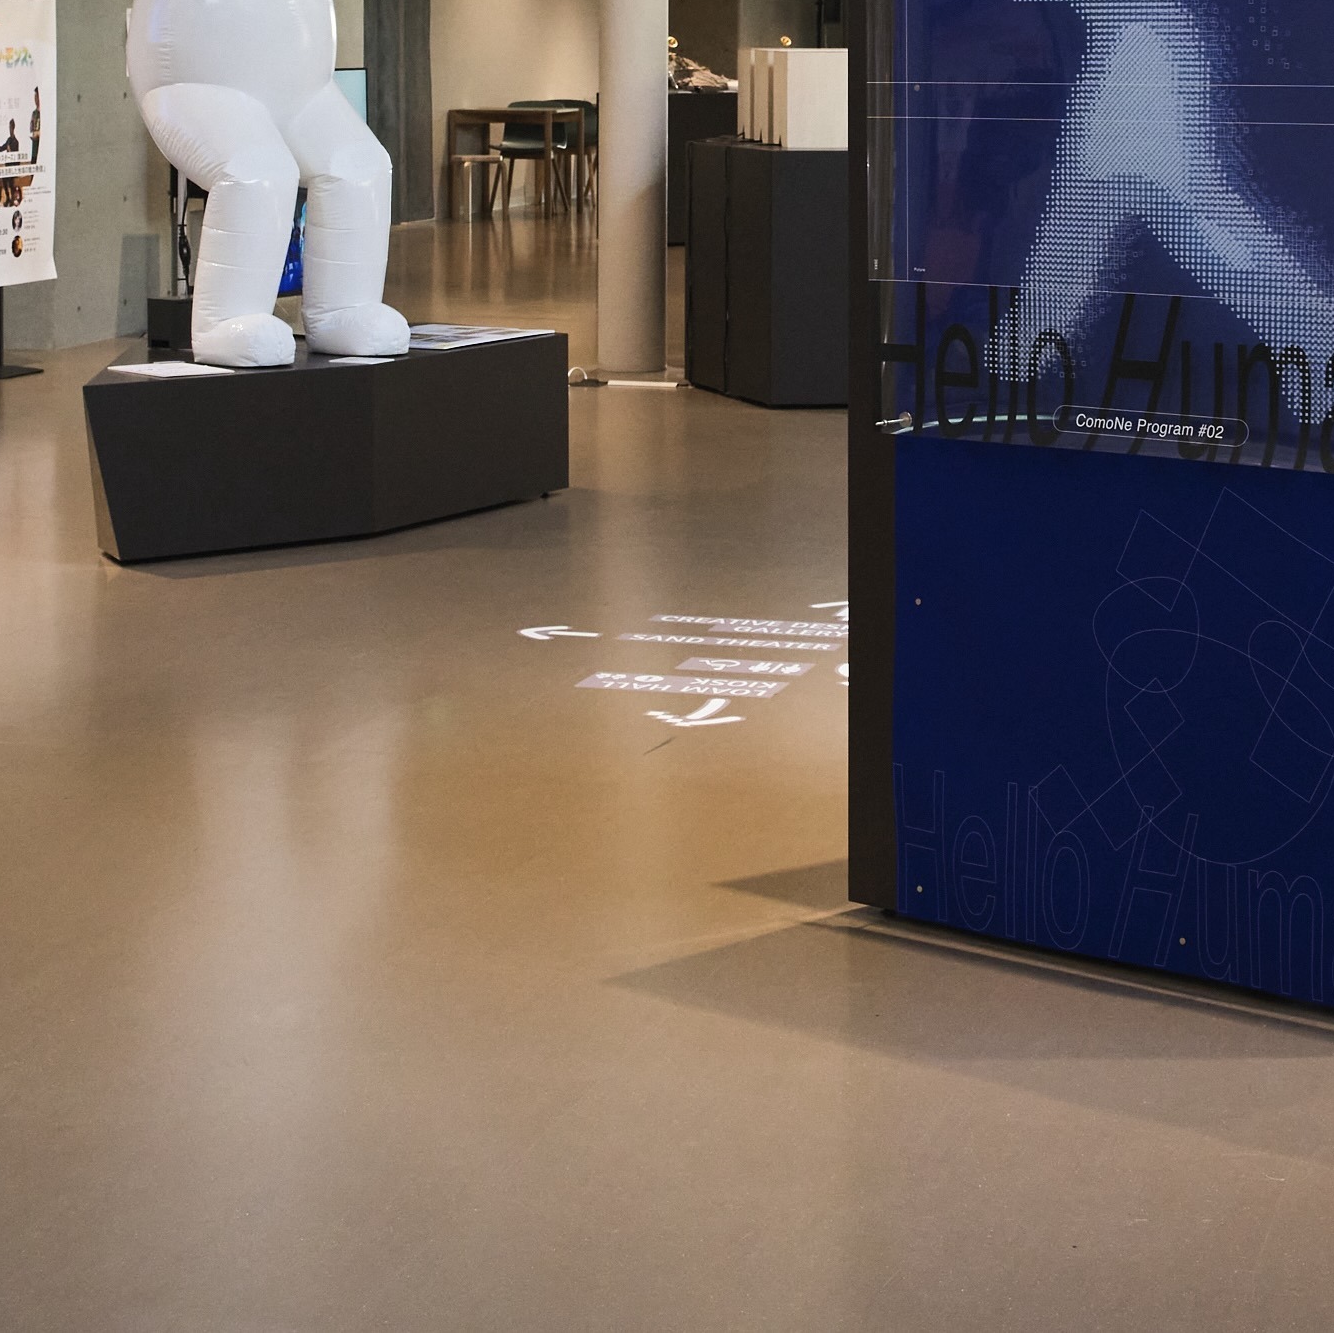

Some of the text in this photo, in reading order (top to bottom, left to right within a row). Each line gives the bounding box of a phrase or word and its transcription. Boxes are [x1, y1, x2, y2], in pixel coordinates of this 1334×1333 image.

[870, 282, 1074, 446] Hello
[1076, 413, 1224, 439] ComoNe Program #02
[660, 615, 785, 627] CREATIVE
[733, 626, 848, 637] GALLERY
[630, 634, 831, 651] SAND THEATER
[602, 680, 767, 696] LOAM HALL
[690, 678, 777, 689] KIOSK
[893, 763, 1090, 950] Hello
